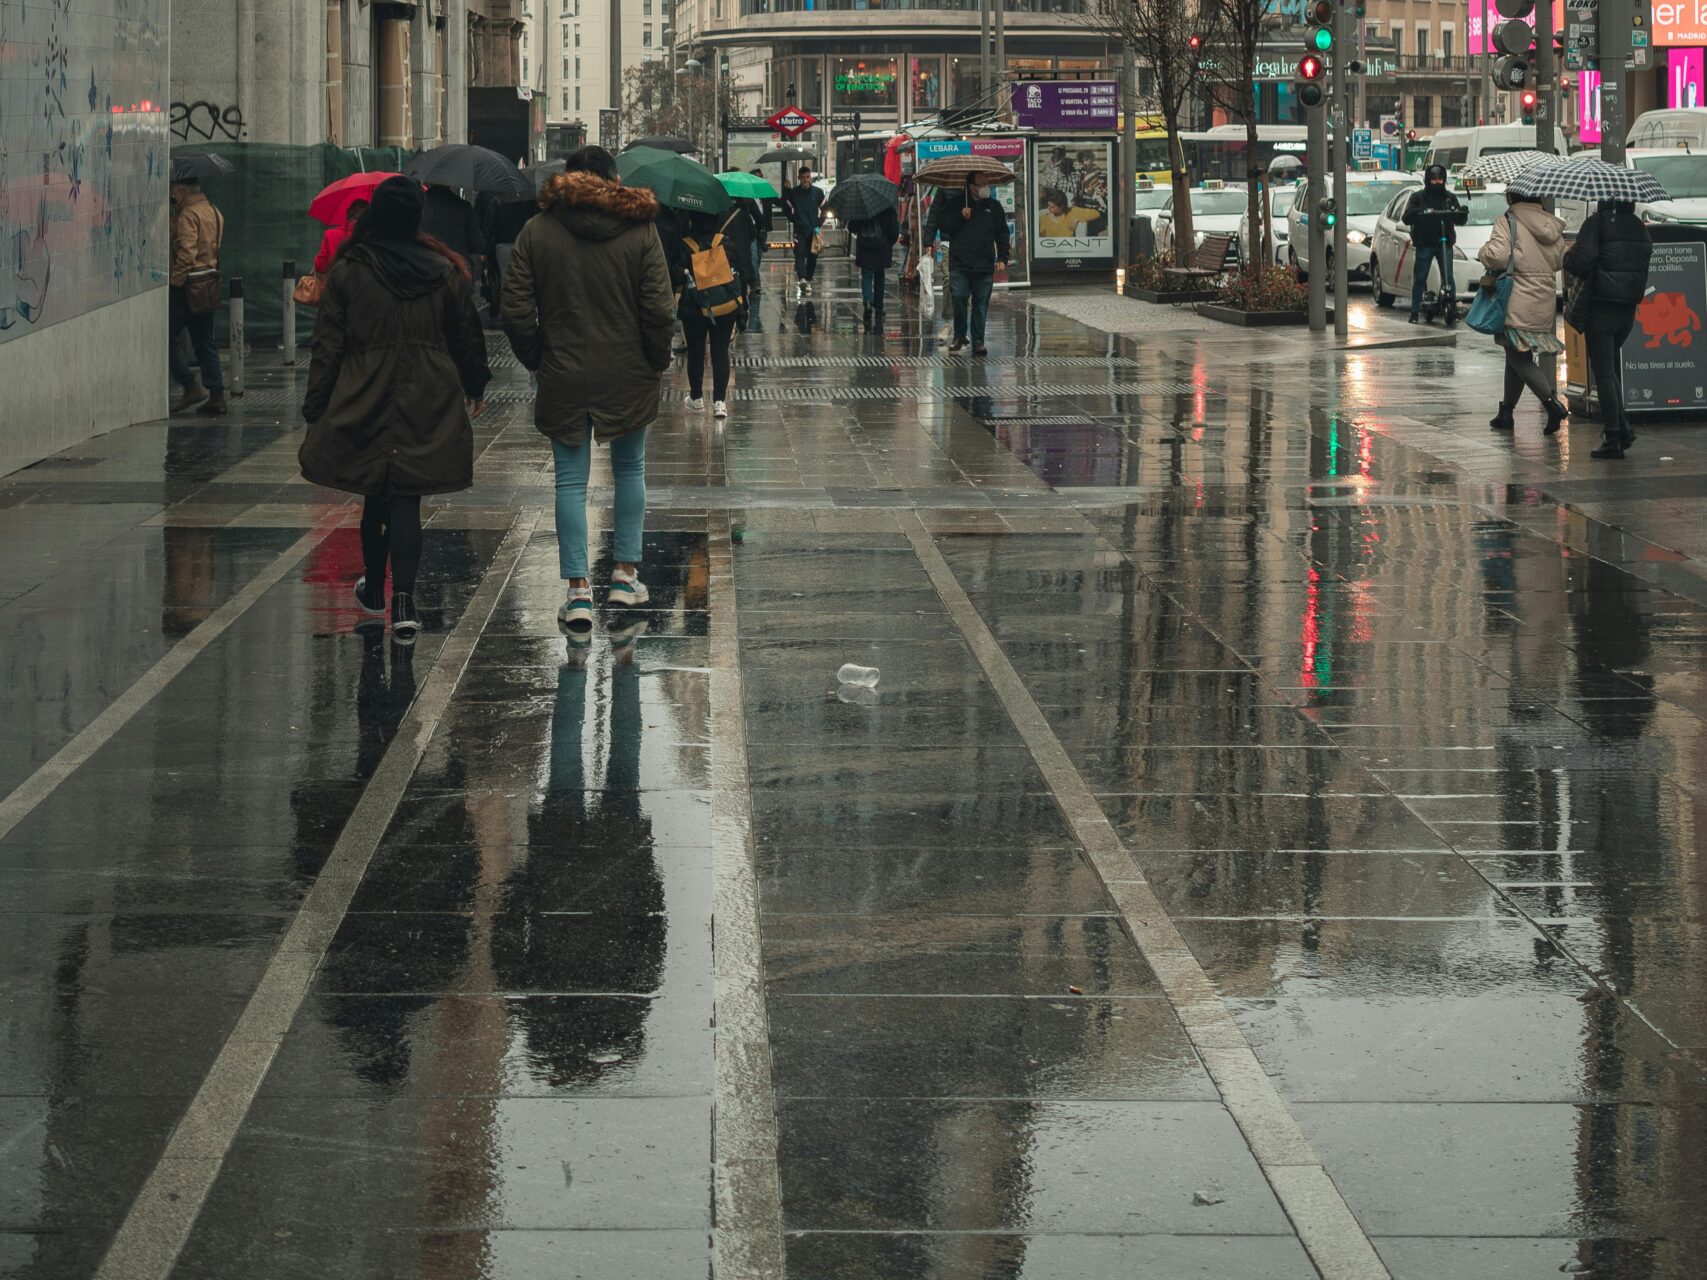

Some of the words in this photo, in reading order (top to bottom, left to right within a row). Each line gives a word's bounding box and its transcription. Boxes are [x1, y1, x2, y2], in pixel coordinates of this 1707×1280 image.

[1568, 0, 1598, 9] KOKO
[1677, 32, 1707, 40] MADRID
[929, 144, 959, 152] LEBARA
[1040, 238, 1108, 249] GANT
[1674, 247, 1693, 255] tiene
[1665, 255, 1698, 265] Deposita
[1657, 263, 1685, 272] colillas.
[1625, 362, 1637, 371] No
[1638, 362, 1649, 370] las
[1649, 361, 1666, 369] tires
[1666, 361, 1674, 369] al
[1674, 360, 1696, 369] suelo.
